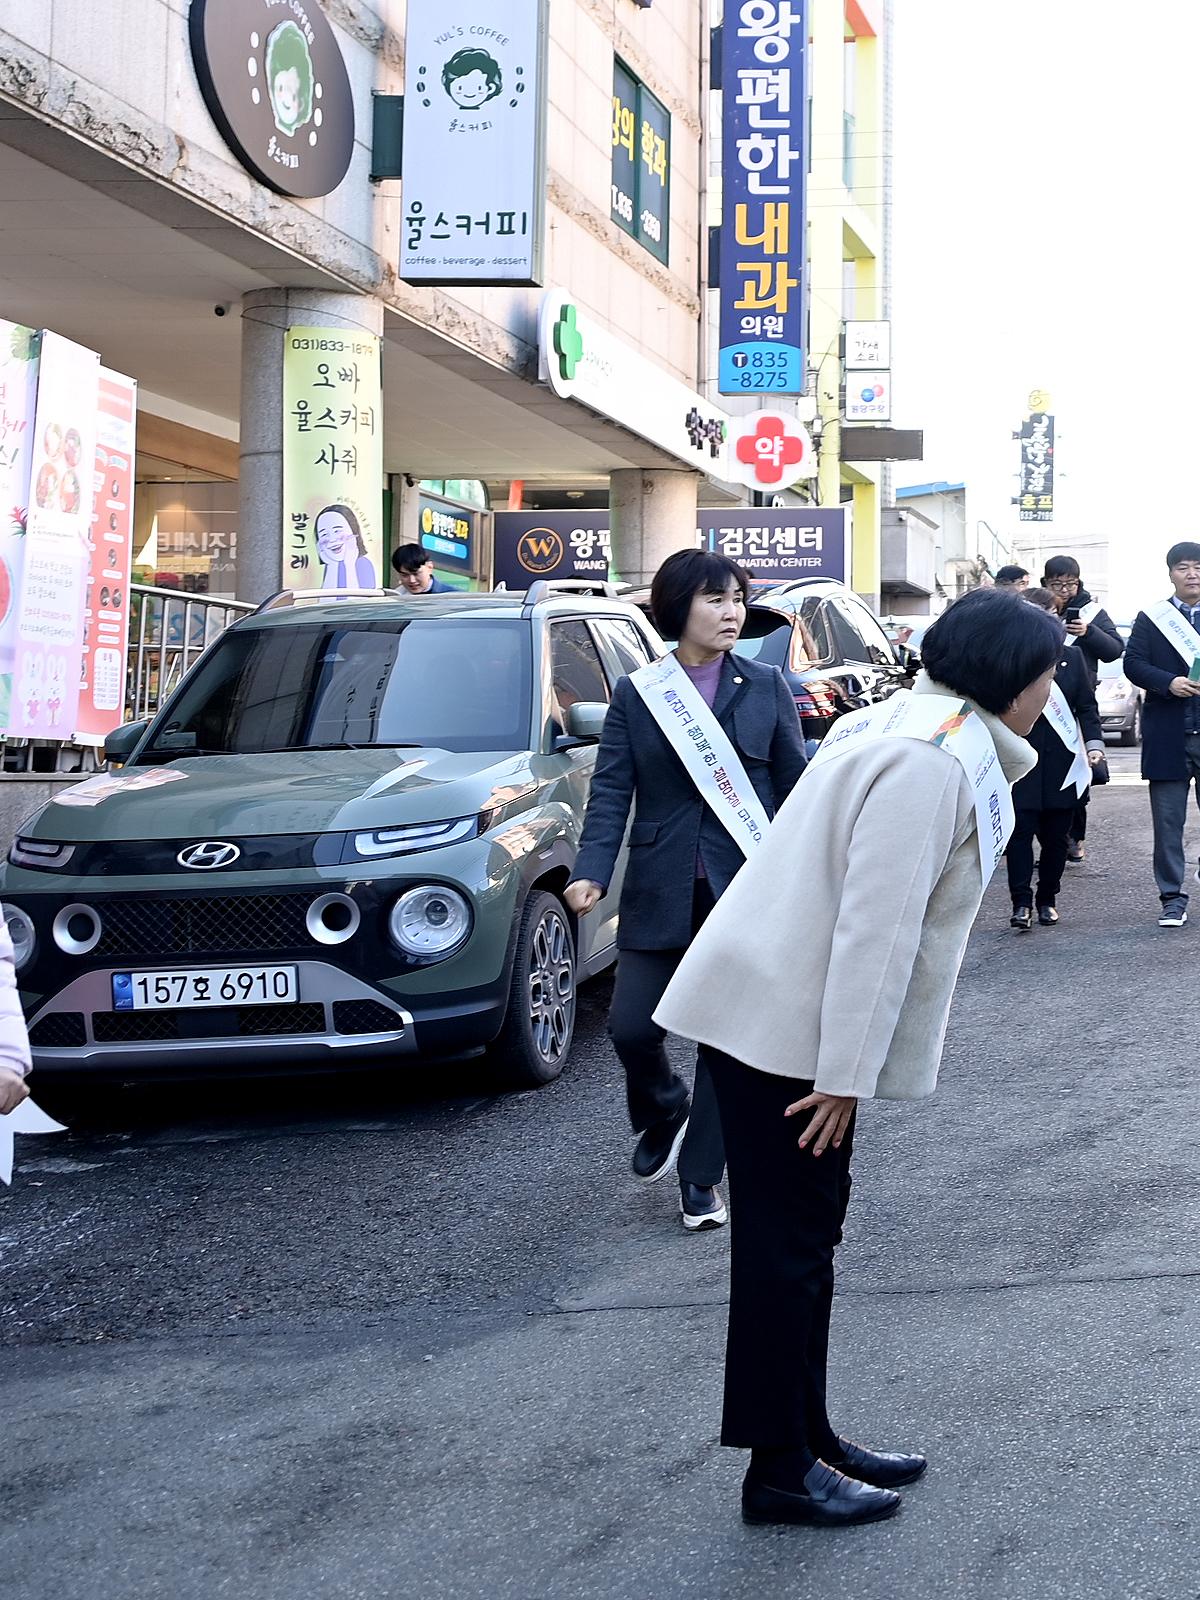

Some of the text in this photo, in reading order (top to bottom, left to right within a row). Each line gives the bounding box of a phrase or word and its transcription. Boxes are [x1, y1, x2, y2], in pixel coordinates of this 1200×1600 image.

[433, 25, 510, 46] YUL'S COFFEE
[448, 118, 493, 132] 율스커피
[733, 0, 801, 313] 왕편한내과
[405, 200, 527, 250] 율스커피
[405, 256, 527, 267] coffee beverage dessert
[740, 315, 784, 338] 의원
[752, 352, 788, 367] 835
[312, 361, 361, 395] 오빠
[731, 372, 788, 388] -8275
[291, 400, 375, 436] 율스커피
[314, 442, 358, 477] 사줘
[755, 435, 784, 467] 약
[718, 526, 823, 555] 검진센터
[573, 560, 606, 570] WANG
[780, 557, 822, 567] CENTER
[687, 725, 718, 767] 행복한
[713, 766, 741, 808] 설명절
[138, 971, 289, 1004] 157호 6910
